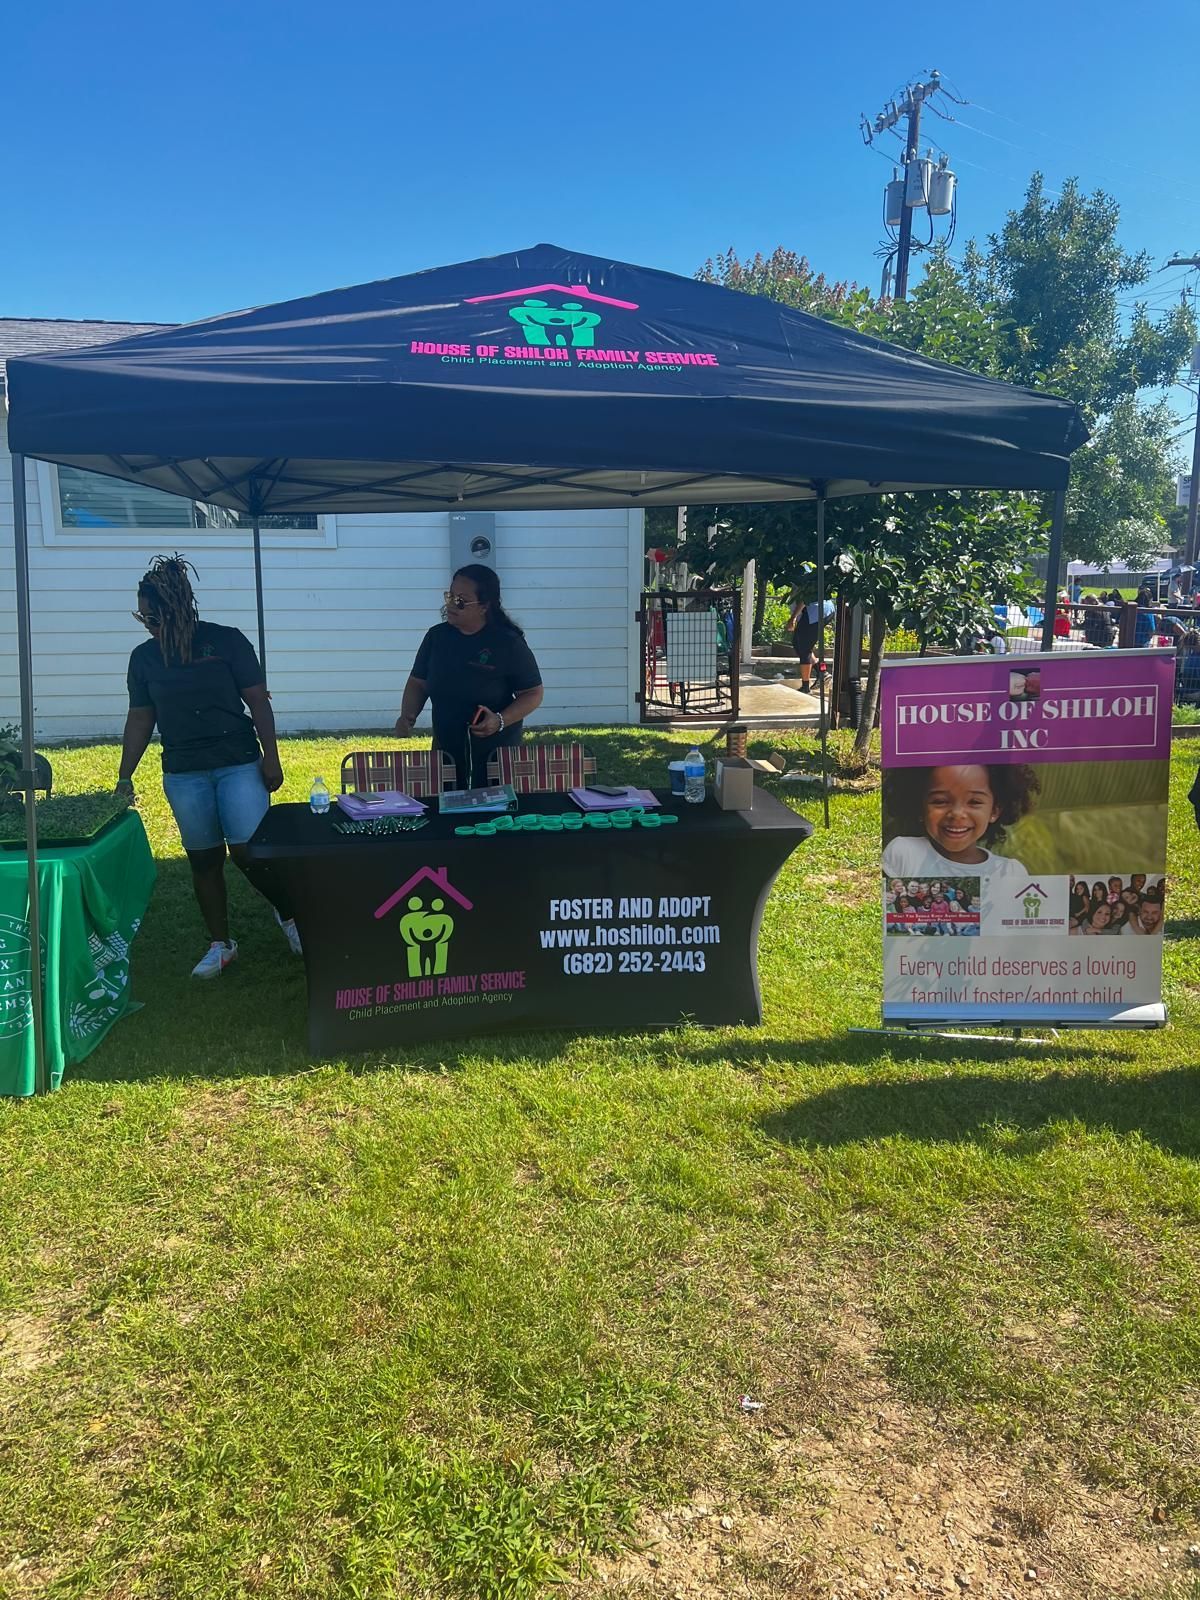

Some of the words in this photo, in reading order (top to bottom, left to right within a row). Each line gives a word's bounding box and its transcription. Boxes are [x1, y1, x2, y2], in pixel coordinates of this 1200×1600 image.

[411, 341, 470, 356] HOUSE
[476, 345, 499, 357] OF
[504, 346, 569, 360] SHILOH
[576, 349, 640, 362] FAMILY
[644, 351, 720, 366] SERVICE
[441, 356, 474, 364] Child
[479, 357, 545, 366] Placement
[578, 361, 634, 370] Adoption
[637, 363, 682, 372] Agency
[898, 702, 992, 725] HOUSE
[998, 700, 1036, 721] OF
[1042, 696, 1155, 719] SHILOH
[1000, 728, 1049, 749] INC
[550, 898, 613, 921] FOSTER
[618, 897, 653, 919] AND
[658, 896, 711, 918] ADOPT
[539, 924, 721, 949] www.hoshiloh.com
[563, 952, 613, 975] (682)
[618, 951, 706, 973] 252-2443
[900, 955, 944, 978] Every
[947, 956, 987, 976] child
[991, 956, 1068, 976] deserves
[1072, 960, 1081, 976] a
[1087, 955, 1136, 979] loving
[336, 987, 373, 1009] HOUSE
[375, 984, 391, 1004] OF
[393, 979, 434, 1001] SHILOH
[437, 974, 478, 996] FAMILY
[480, 970, 526, 992] SERVICE
[1083, 986, 1122, 1004] child
[349, 1009, 373, 1021] Child
[375, 1003, 421, 1016] Placement
[423, 999, 439, 1009] and
[441, 994, 480, 1007] Adoption
[482, 992, 513, 1004] Agency
